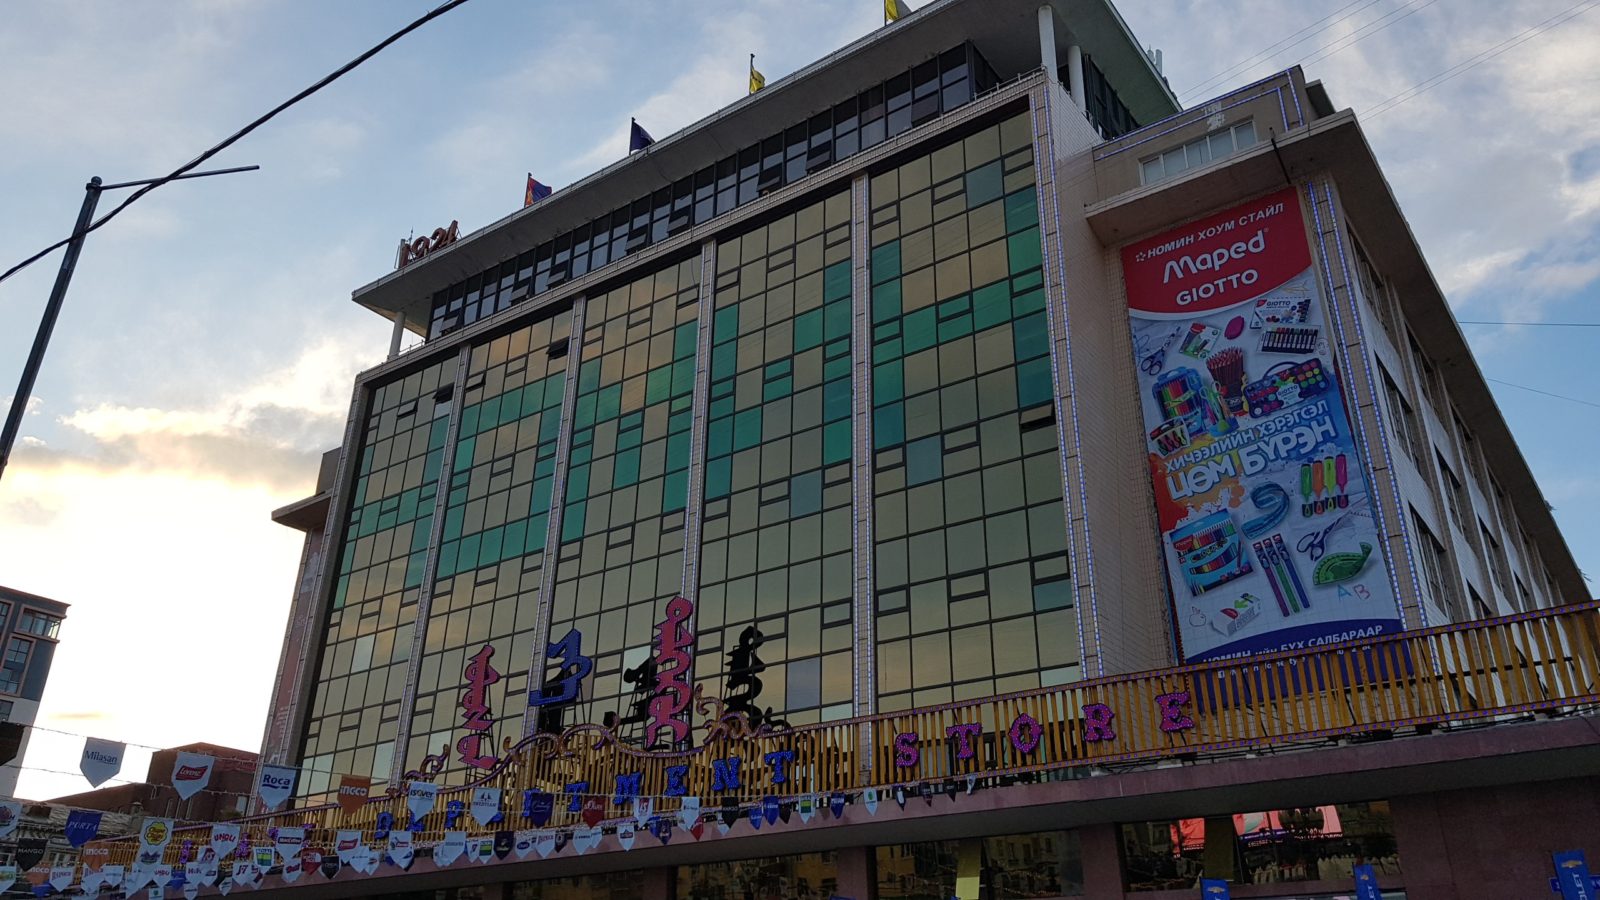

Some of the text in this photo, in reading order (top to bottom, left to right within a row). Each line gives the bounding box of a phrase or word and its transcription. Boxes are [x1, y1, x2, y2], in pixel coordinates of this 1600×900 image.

[1147, 202, 1284, 259] НОМИН ХОУМ СТАЙЛ
[1163, 229, 1266, 284] Maped
[1176, 269, 1259, 306] GIOTTO
[1165, 399, 1330, 474] ХИЧЭЭЛИЙН ХЭРЭГСЭЛ
[1168, 415, 1337, 501] ЦӨМ БҮРЭН
[1308, 624, 1384, 648] САЛБАРААР
[895, 691, 1195, 769] STORE
[84, 750, 118, 765] Milasan
[262, 774, 291, 785] Roca
[68, 821, 98, 832] PORTA
